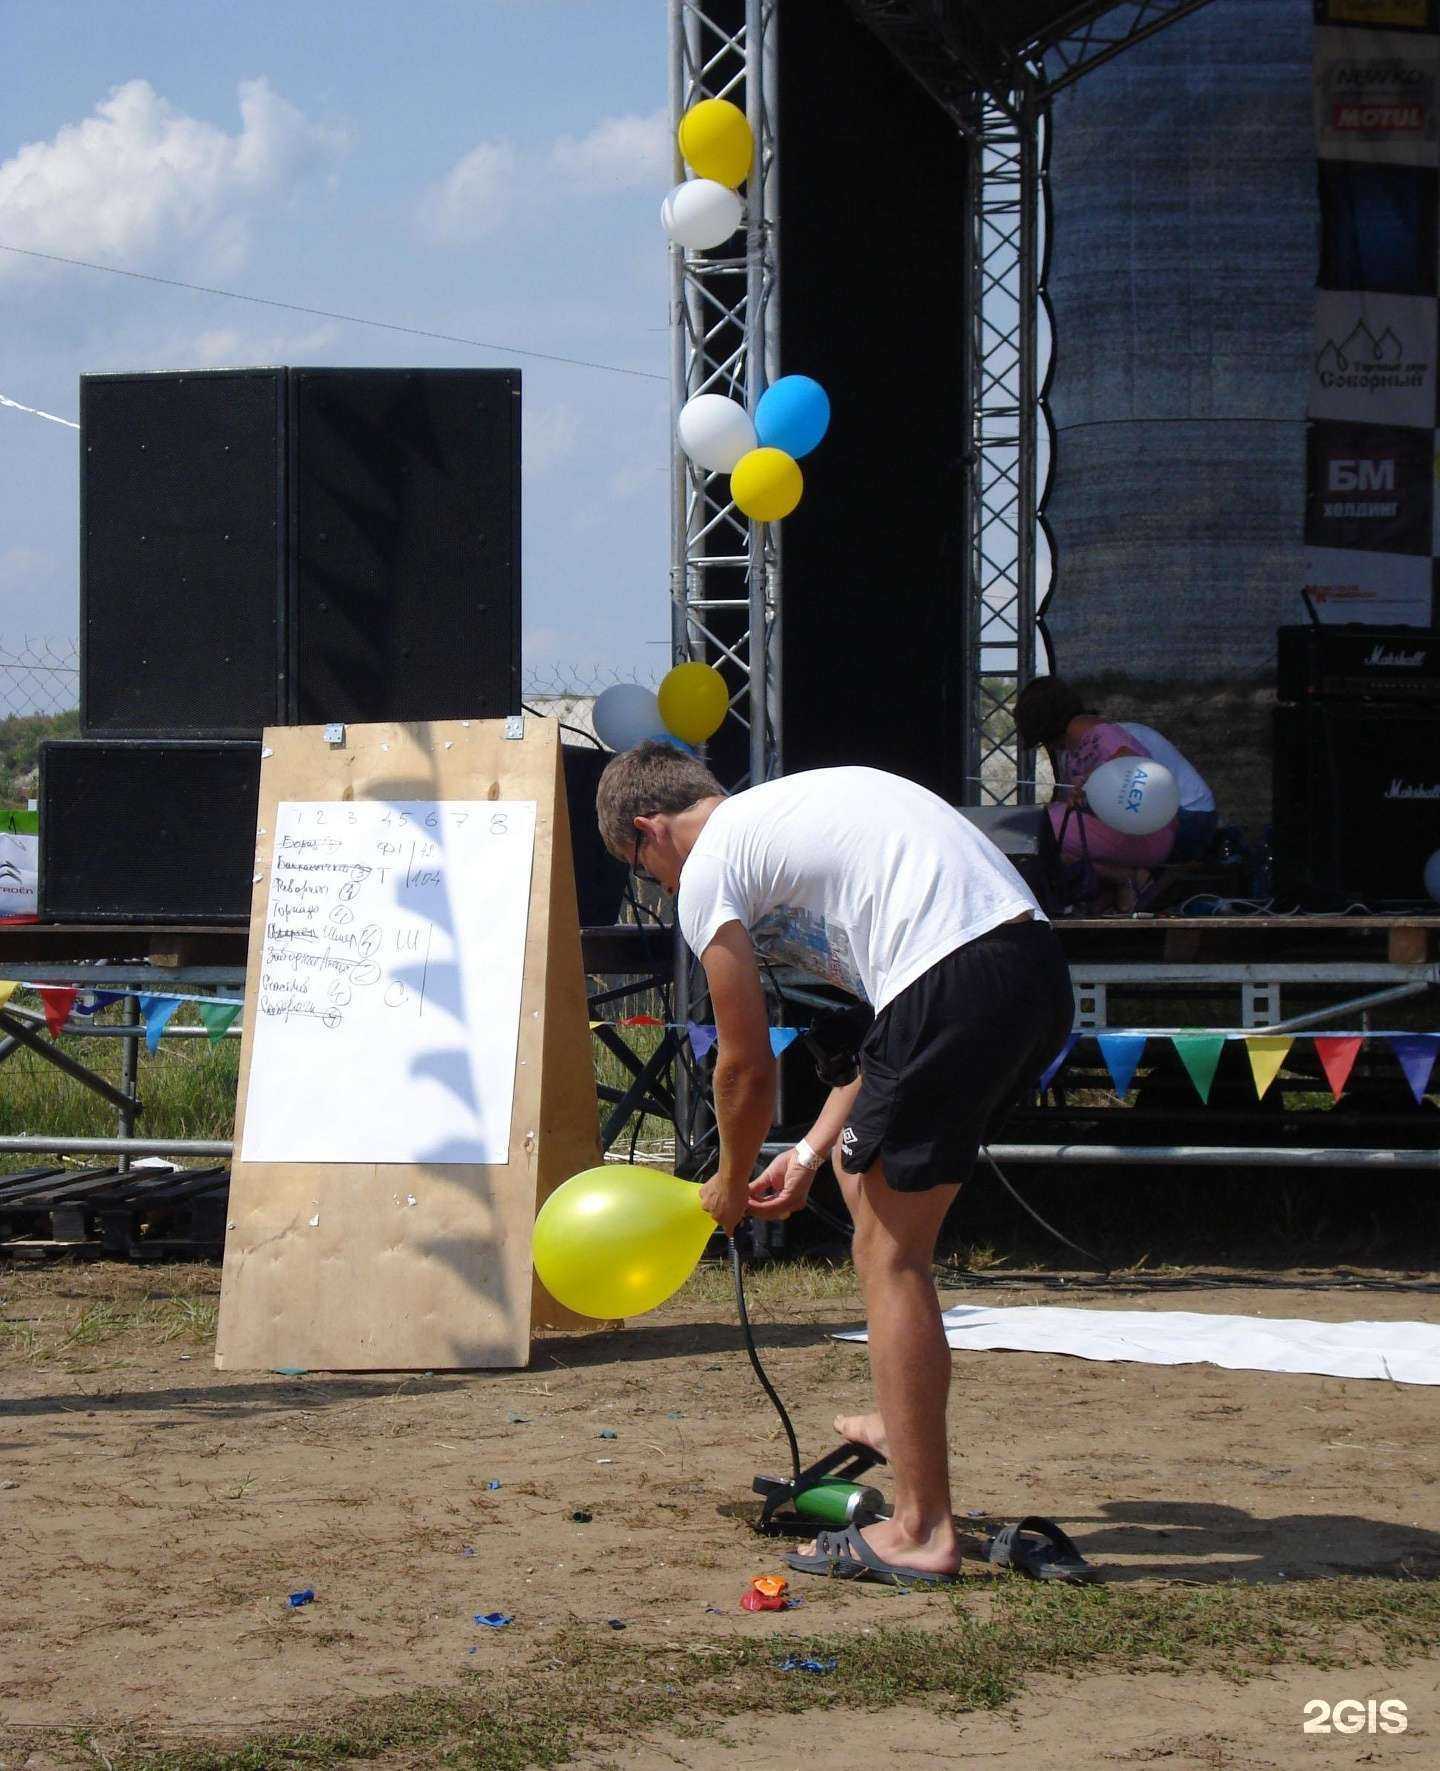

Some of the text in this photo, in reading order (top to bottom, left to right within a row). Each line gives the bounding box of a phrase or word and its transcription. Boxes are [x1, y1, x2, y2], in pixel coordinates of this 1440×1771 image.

[1336, 107, 1420, 127] MOTUL
[1328, 459, 1395, 491] БМ
[1364, 645, 1427, 666] Marshall
[1125, 768, 1149, 814] ALEX
[1384, 779, 1440, 799] Marshal
[316, 810, 328, 825] 2
[347, 811, 358, 825] 3
[381, 810, 391, 828] 4
[399, 812, 412, 828] 5
[424, 812, 438, 828] 6
[489, 814, 509, 835] 8
